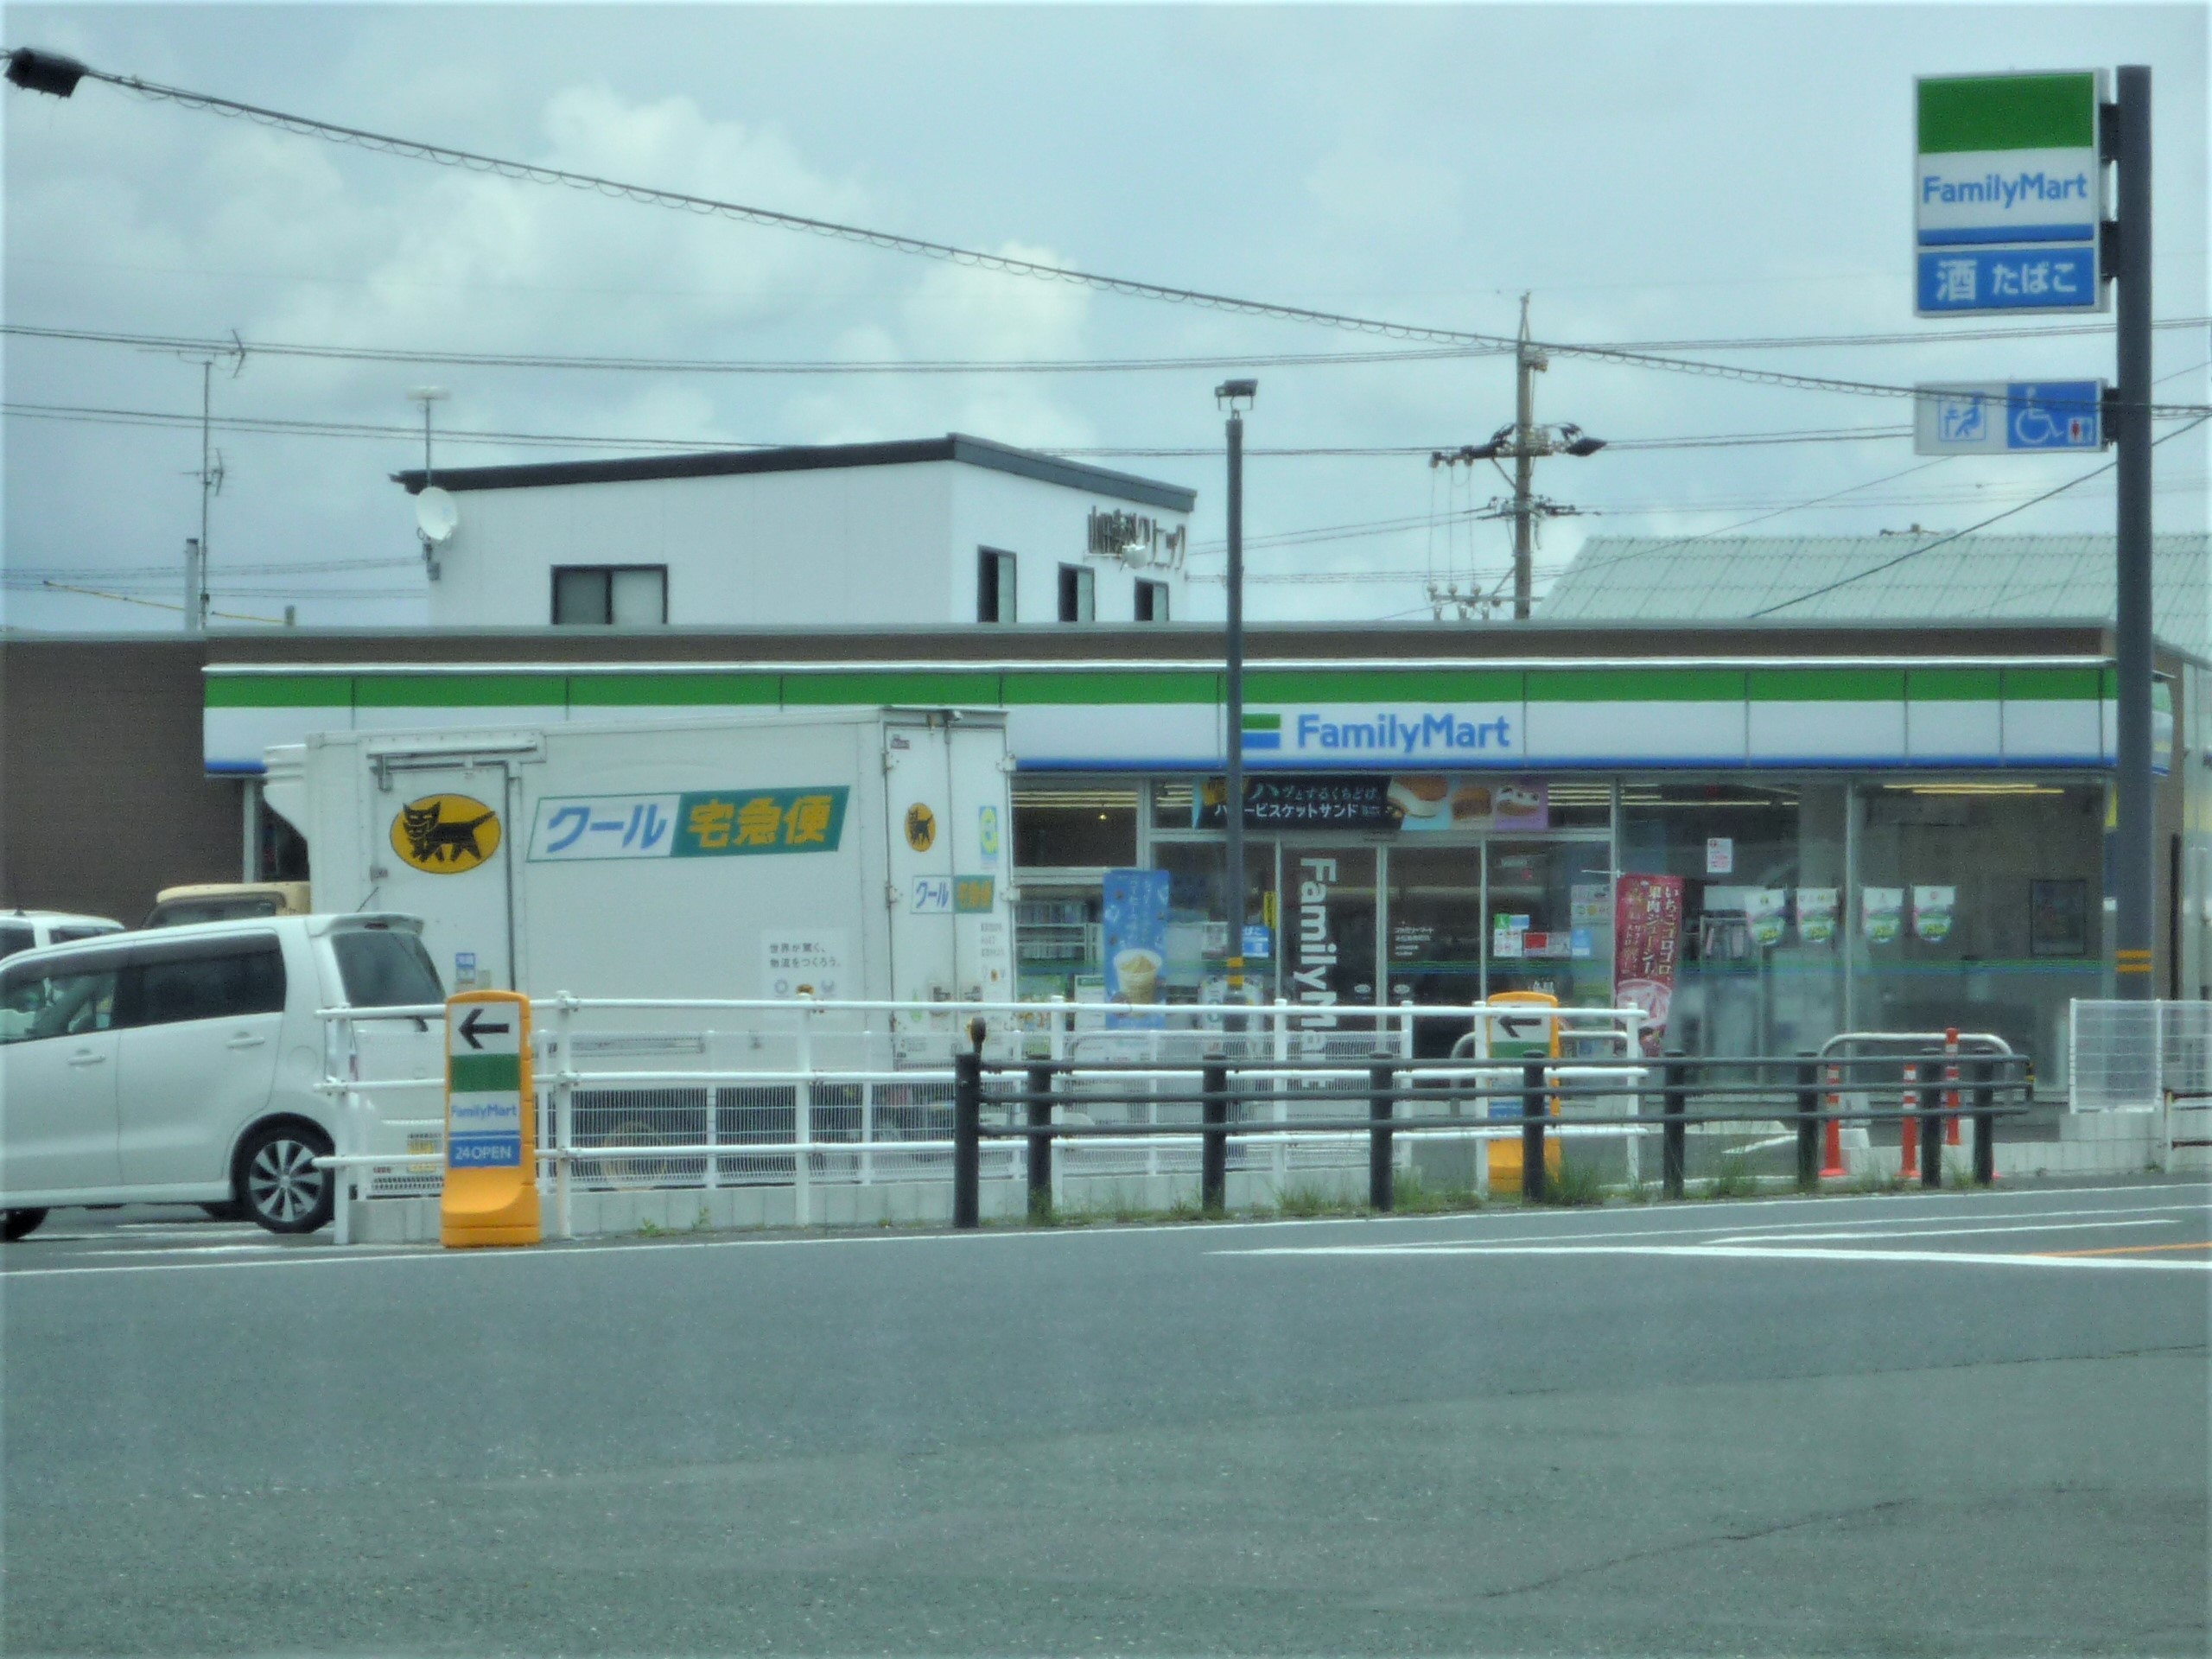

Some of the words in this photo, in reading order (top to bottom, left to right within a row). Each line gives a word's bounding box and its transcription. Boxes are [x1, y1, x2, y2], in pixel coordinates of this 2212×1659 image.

[1923, 171, 2088, 209] FamilyMart
[1936, 259, 1977, 302] 酒
[1991, 262, 2077, 296] たばこ
[1298, 713, 1510, 753] FamilyMart
[546, 803, 669, 854] クール
[687, 795, 834, 849] 宅急便
[915, 880, 950, 909] クール
[1294, 858, 1338, 1090] FamilyMa
[451, 1103, 518, 1121] FamilyMart
